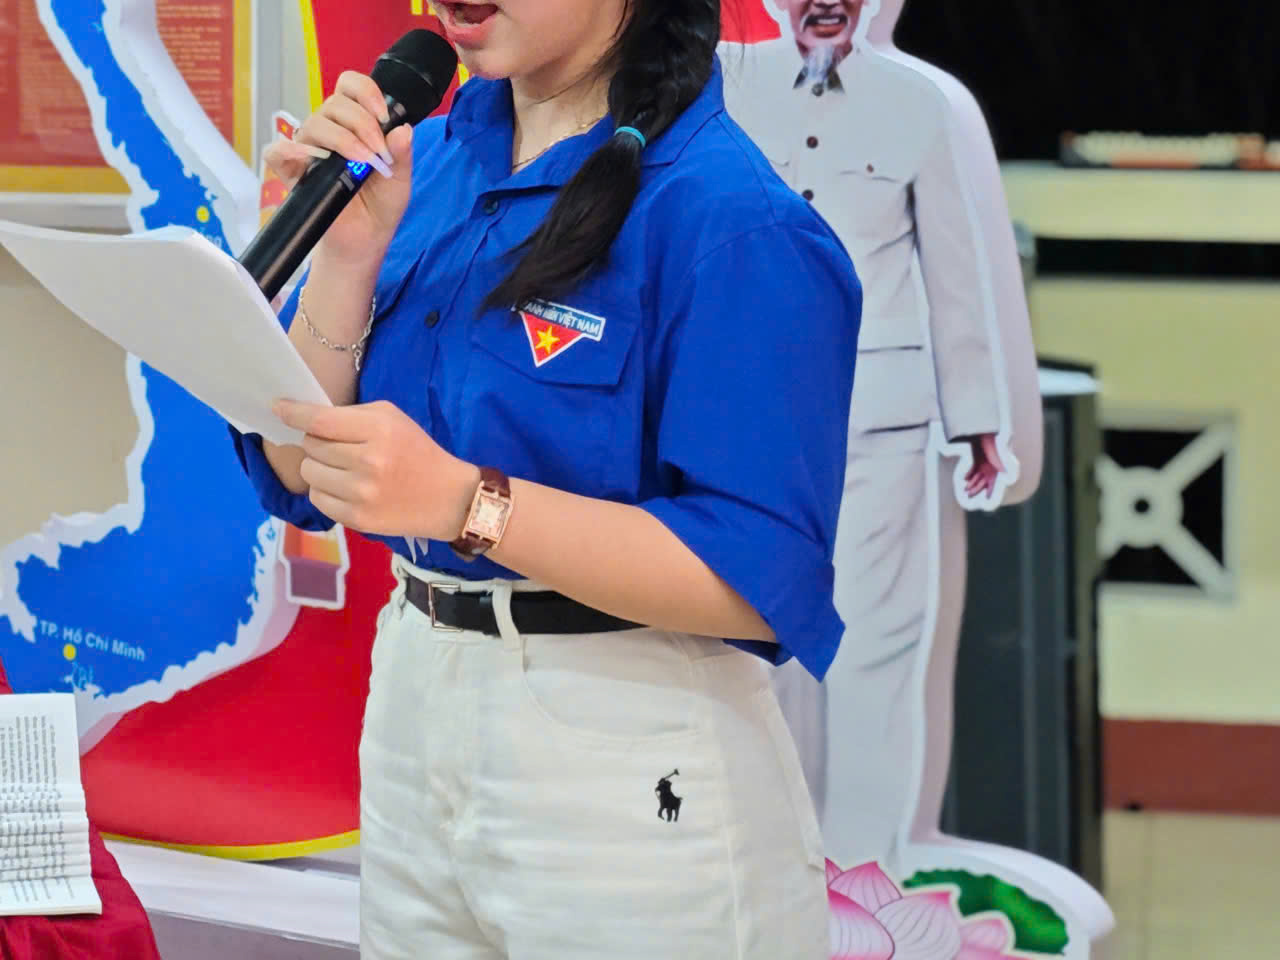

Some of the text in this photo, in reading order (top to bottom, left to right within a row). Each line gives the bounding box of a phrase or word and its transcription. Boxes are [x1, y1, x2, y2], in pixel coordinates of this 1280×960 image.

[558, 311, 577, 329] VIỆT
[577, 318, 601, 336] NAM
[63, 626, 83, 645] Hồ
[85, 631, 109, 652] Chí
[112, 639, 146, 663] Minh
